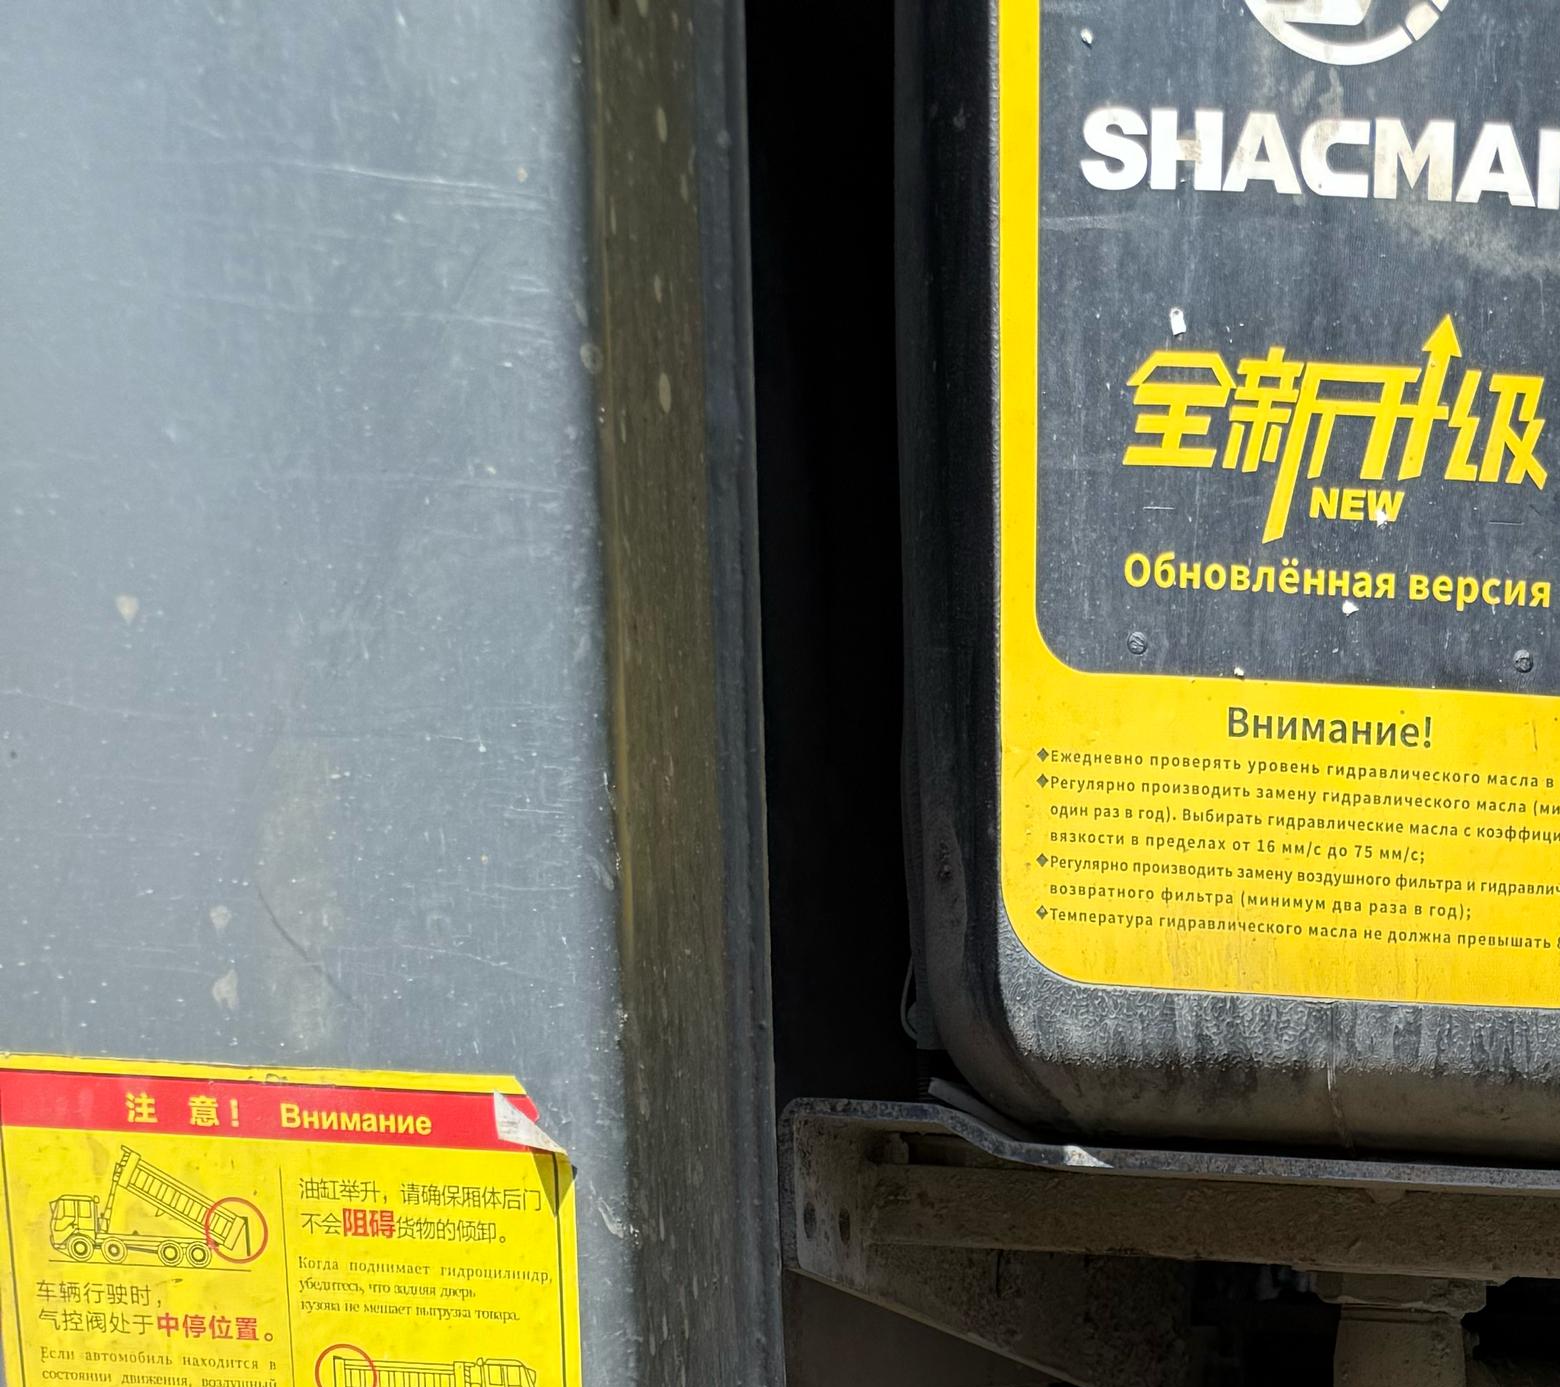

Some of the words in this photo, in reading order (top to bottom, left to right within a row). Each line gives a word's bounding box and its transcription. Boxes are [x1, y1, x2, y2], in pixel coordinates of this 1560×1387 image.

[1122, 314, 1549, 543] 全新升级
[1309, 487, 1404, 522] NEW
[1124, 551, 1396, 600] Обновлённая
[1409, 573, 1551, 612] версия
[1228, 706, 1432, 749] Внимание!
[1051, 749, 1144, 767] Ежедневно
[1149, 755, 1242, 772] проверять
[1247, 759, 1321, 775] уровень
[1326, 764, 1481, 785] гидравлического
[1486, 774, 1539, 788] масла
[1545, 777, 1555, 789] в
[1050, 775, 1136, 795] Регулярно
[1141, 781, 1251, 800] производить
[1255, 787, 1317, 806] замену
[1322, 791, 1471, 810] гидравлического
[1476, 799, 1527, 814] масла
[1049, 804, 1089, 820] один
[1093, 807, 1120, 821] раз
[1124, 808, 1134, 819] в
[1138, 805, 1177, 824] год).
[1182, 807, 1263, 828] Выбирать
[1267, 815, 1404, 834] гидравлические
[1409, 823, 1458, 837] масла
[1463, 826, 1472, 838] с
[1050, 831, 1125, 846] вязкости
[1131, 835, 1139, 846] в
[1145, 835, 1226, 854] пределах
[1232, 840, 1251, 852] от
[1256, 838, 1276, 854] 16
[1281, 840, 1322, 861] мм/с
[1327, 842, 1348, 861] до
[1353, 844, 1373, 859] 75
[1379, 845, 1425, 865] мм/с;
[1050, 854, 1129, 875] Регулярно
[1132, 861, 1233, 880] производить
[1236, 867, 1294, 885] замену
[1297, 866, 1392, 888] воздушного
[1395, 872, 1463, 894] фильтра
[1466, 880, 1476, 892] и
[1049, 882, 1155, 903] возвратного
[1160, 886, 1234, 908] фильтра
[1240, 889, 1326, 913] (минимум
[1331, 899, 1362, 915] два
[1368, 901, 1408, 917] раза
[1414, 904, 1423, 916] в
[1429, 903, 1471, 921] год);
[1049, 907, 1153, 929] Температура
[1159, 915, 1303, 936] гидравлического
[1308, 925, 1358, 939] масла
[1363, 928, 1383, 941] не
[1387, 930, 1451, 945] должна
[1457, 934, 1552, 949] превышать
[280, 1103, 432, 1136] Внимание
[298, 1256, 339, 1271] Когда
[349, 1260, 431, 1276] поднимает
[368, 1284, 391, 1294] что
[344, 1302, 360, 1313] не
[40, 1346, 75, 1361] Если
[85, 1351, 173, 1366] автомобиль
[182, 1355, 259, 1370] находится
[42, 1369, 112, 1383] состоянии
